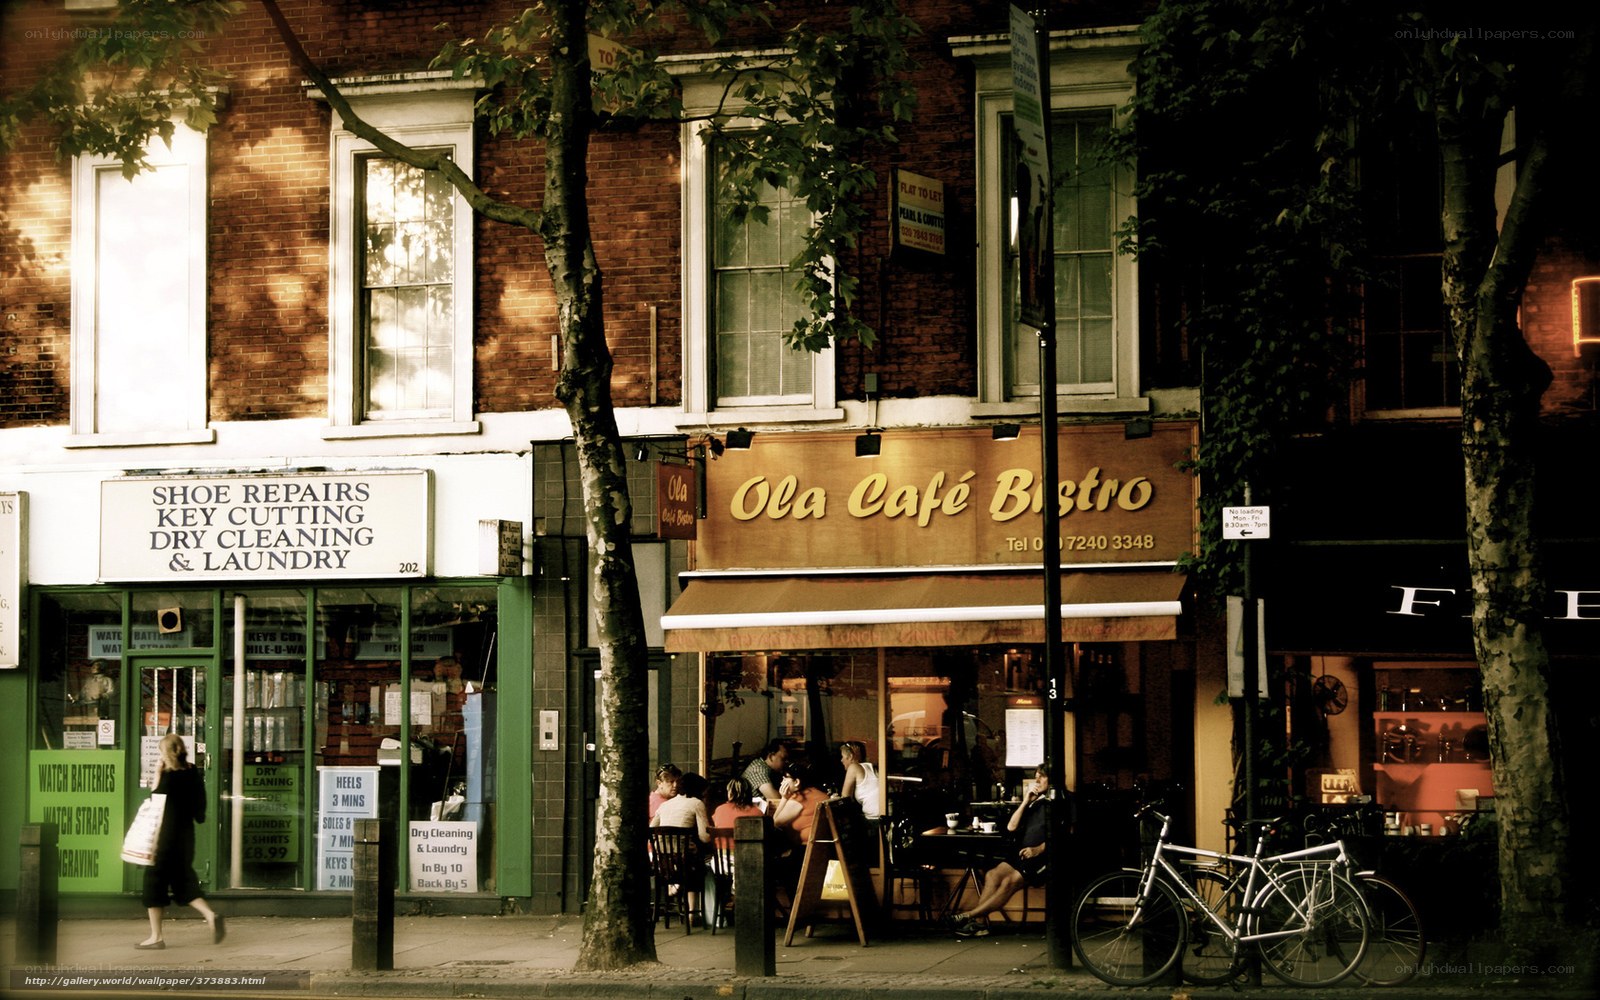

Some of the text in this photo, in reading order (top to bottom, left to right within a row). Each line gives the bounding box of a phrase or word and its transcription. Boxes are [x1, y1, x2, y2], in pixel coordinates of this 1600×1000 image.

[598, 49, 613, 66] TO
[901, 182, 942, 202] FLAT TO LET
[152, 482, 370, 505] SHOE REPAIRS
[668, 474, 687, 502] Ola
[730, 474, 826, 521] Ola
[848, 470, 975, 527] Café
[156, 504, 365, 528] KEY CUTTING
[149, 527, 374, 550] DRY CLEANING
[1006, 537, 1028, 551] Tel
[1067, 536, 1108, 550] 7240
[1112, 534, 1154, 550] 3348
[169, 549, 351, 572] & LAUNDRY
[399, 562, 419, 574] 202
[97, 631, 122, 641] WATC
[248, 633, 276, 641] KEYS
[246, 645, 306, 654] HILE-U-WA
[39, 764, 68, 792] WATCH
[71, 764, 115, 792] BATTERIES
[256, 768, 277, 776] DRY
[245, 778, 293, 786] LEANING
[336, 777, 362, 789] HEELS
[333, 794, 365, 807] 3 MINS
[76, 807, 109, 835] STRAPS
[323, 817, 351, 830] SOLES &
[253, 835, 289, 844] SHIRTS
[411, 829, 473, 840] Dry Cleaning
[331, 835, 336, 847] 7
[246, 847, 287, 859] £8.99
[426, 845, 467, 856] Laundry
[58, 850, 99, 878] NGRAVING
[325, 857, 347, 870] KEYS
[422, 864, 462, 875] In By 10
[330, 875, 336, 887] 2
[418, 879, 467, 891] Back By 5
